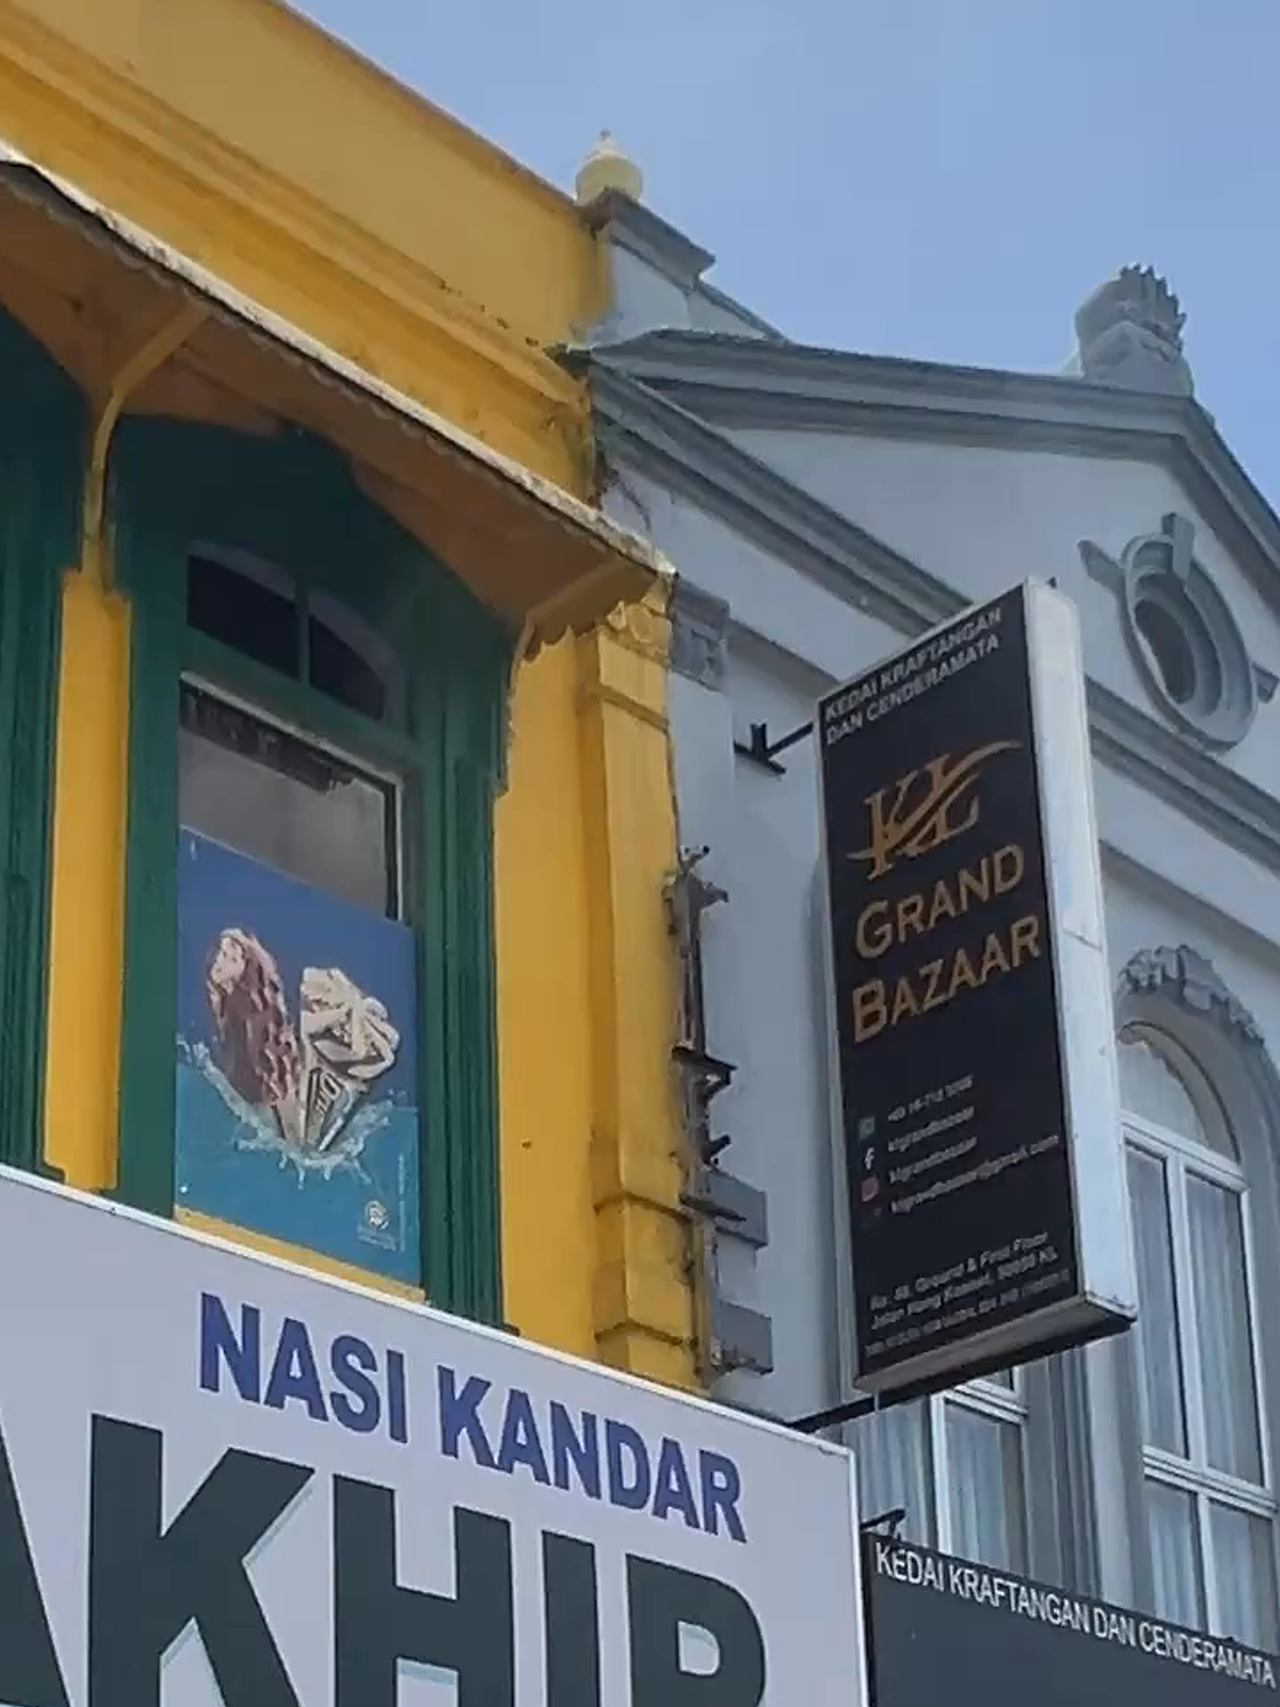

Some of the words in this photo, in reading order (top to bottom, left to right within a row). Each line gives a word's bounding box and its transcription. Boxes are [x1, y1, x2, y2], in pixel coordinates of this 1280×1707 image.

[827, 713, 863, 745] DAN
[856, 844, 1025, 959] GRAND
[852, 915, 1040, 1043] BAZAAR
[200, 1291, 407, 1444] NASI
[438, 1364, 748, 1543] KANDAR
[875, 1541, 944, 1592] KEDAI
[949, 1560, 1090, 1635] KRAFTANGAN
[1094, 1606, 1136, 1648] DAN
[1138, 1621, 1277, 1689] CENDERAMATA
